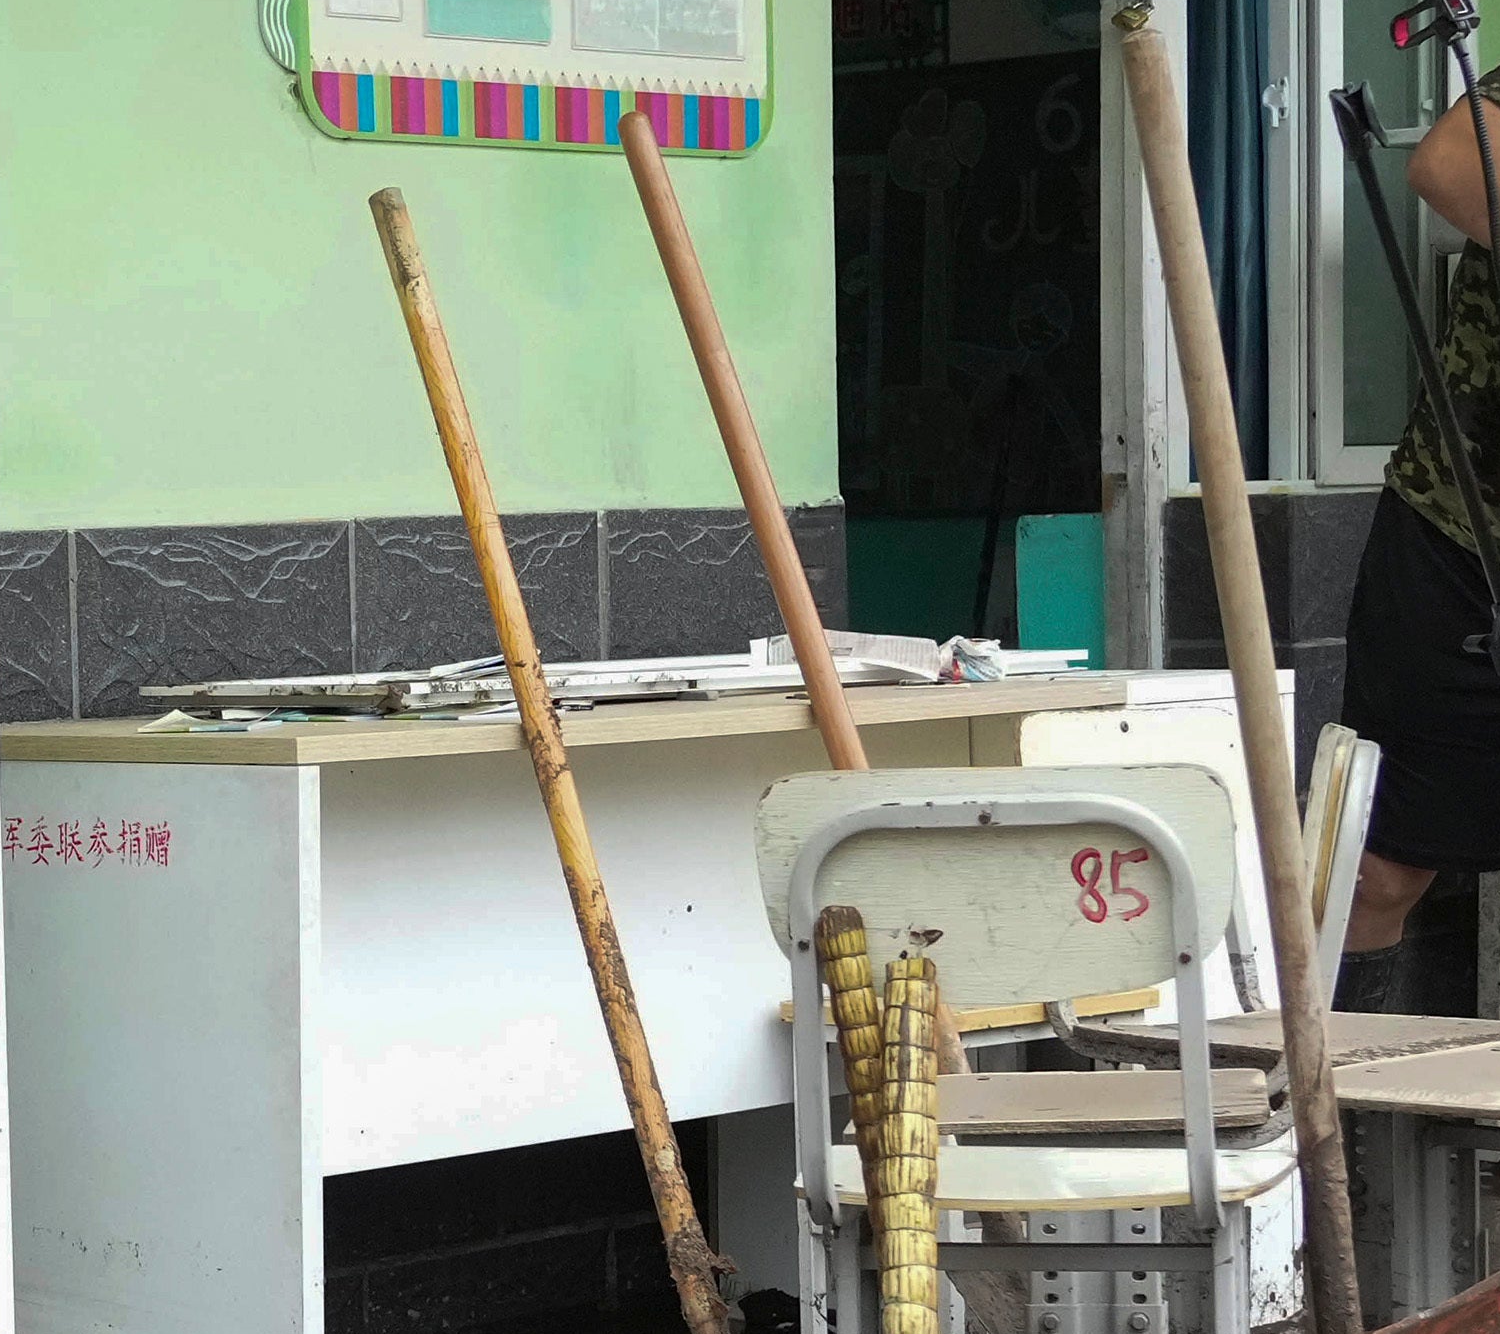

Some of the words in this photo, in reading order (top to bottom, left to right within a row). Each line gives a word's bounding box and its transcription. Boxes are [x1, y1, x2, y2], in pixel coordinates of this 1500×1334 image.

[2, 815, 172, 869] 军委联参捐赠
[1071, 847, 1149, 923] 85
